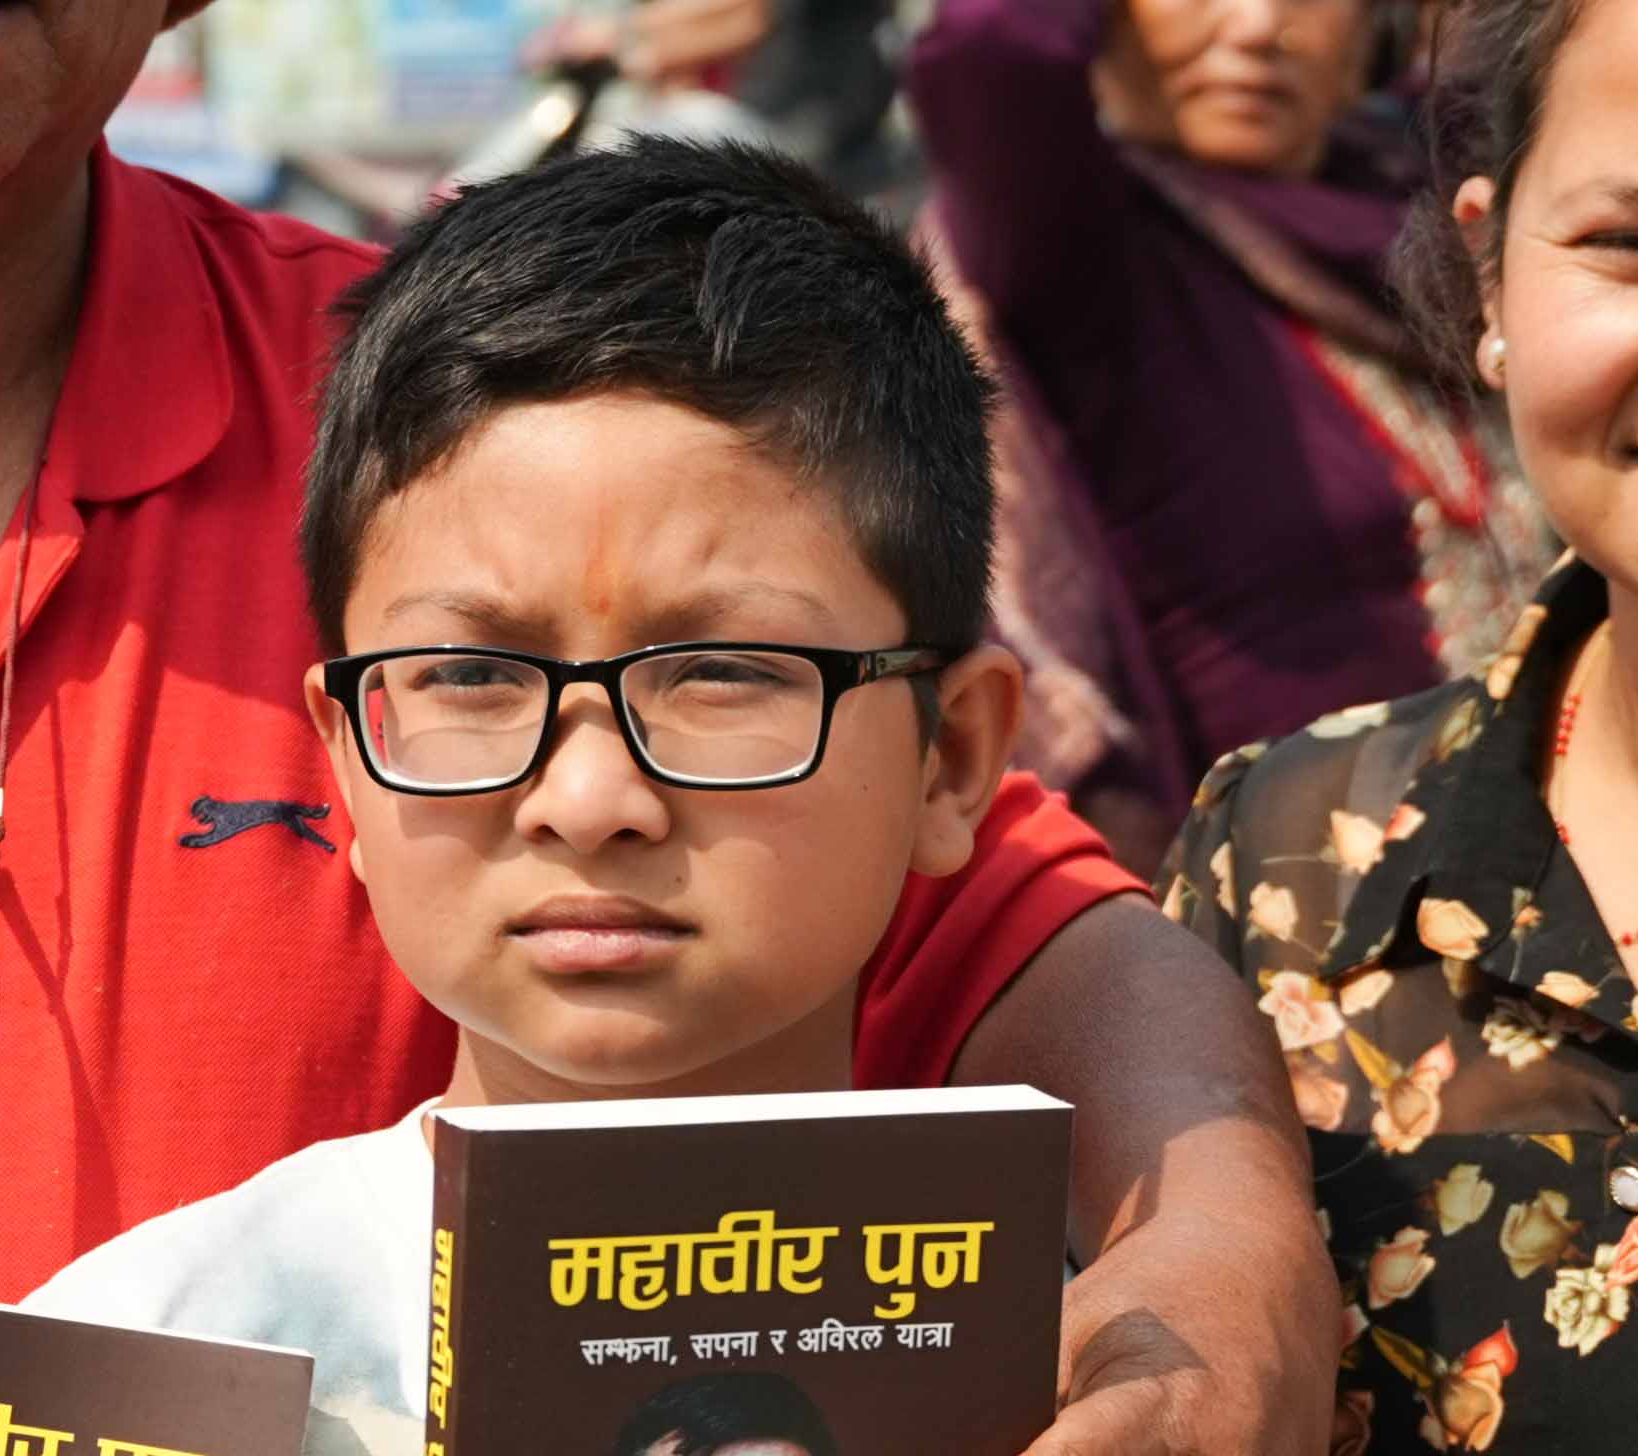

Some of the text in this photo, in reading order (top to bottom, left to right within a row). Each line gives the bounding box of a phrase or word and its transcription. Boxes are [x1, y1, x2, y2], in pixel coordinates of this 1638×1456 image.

[547, 1209, 996, 1320] महावीर पुन
[428, 1228, 454, 1430] महावीर
[578, 1316, 955, 1367] सम्झना, सपना र अविरल यात्रा
